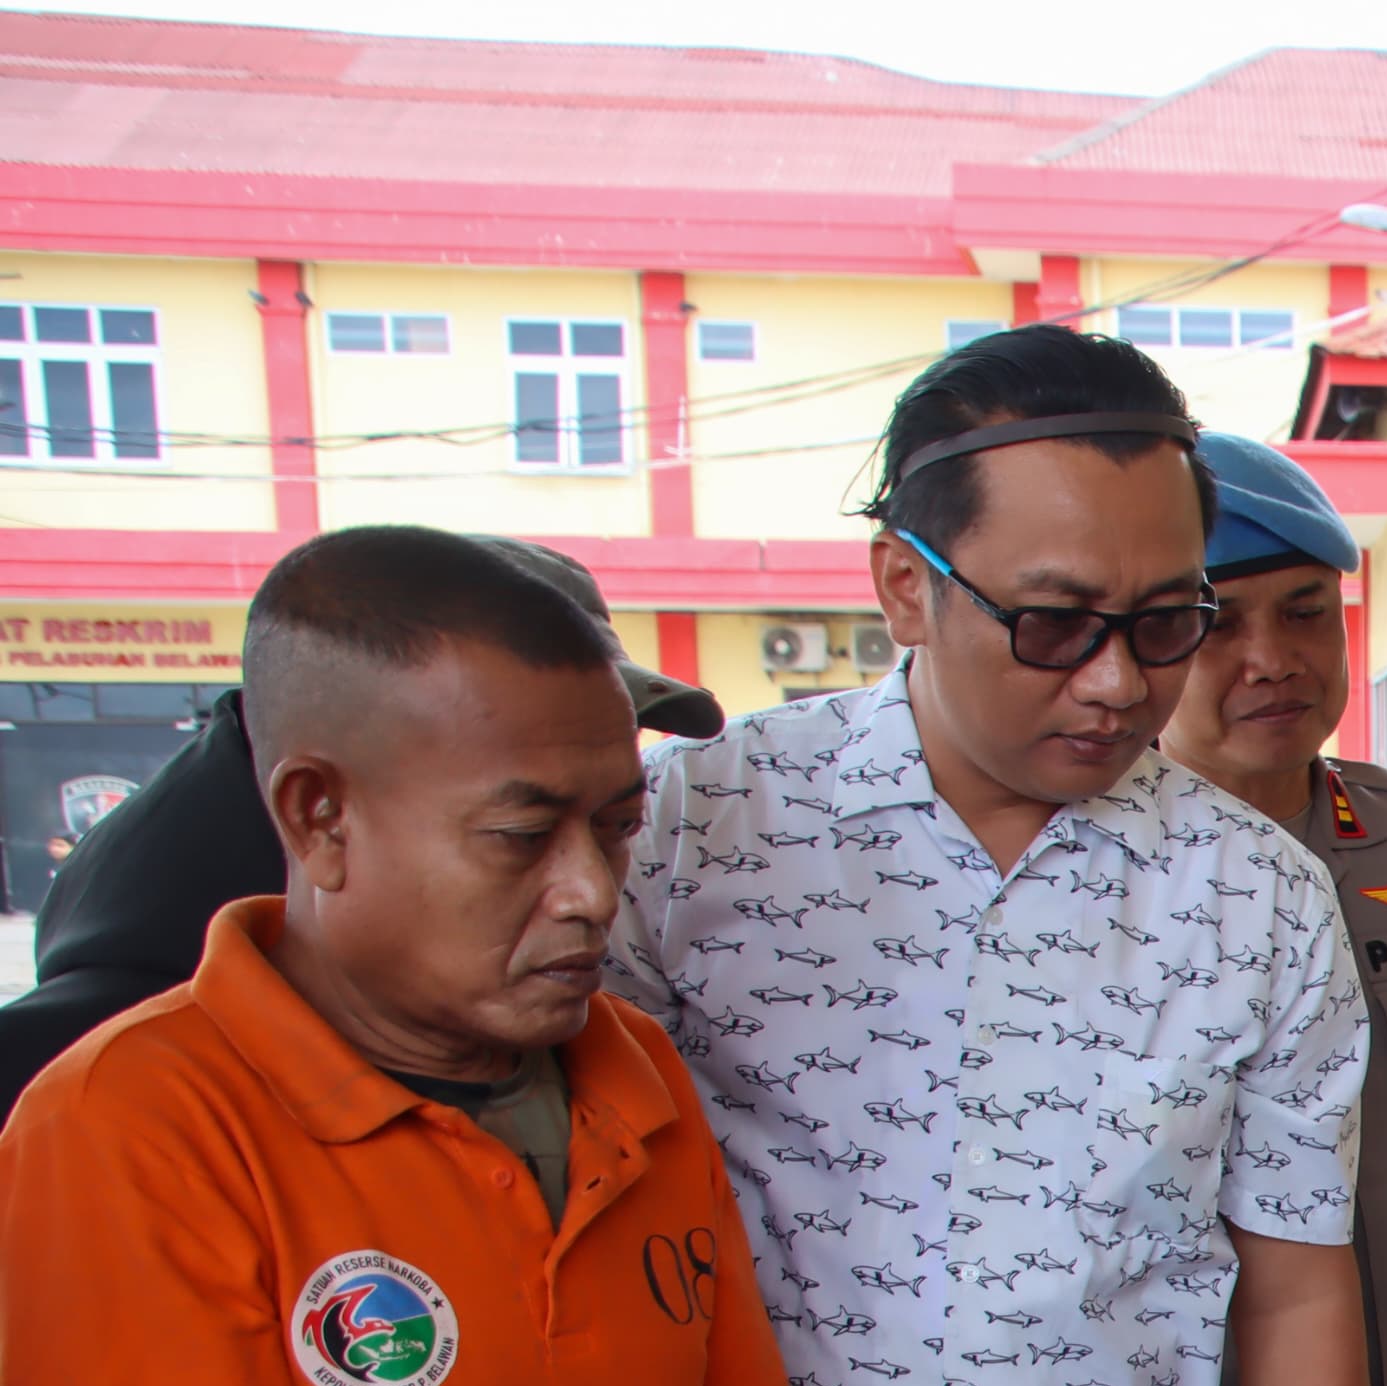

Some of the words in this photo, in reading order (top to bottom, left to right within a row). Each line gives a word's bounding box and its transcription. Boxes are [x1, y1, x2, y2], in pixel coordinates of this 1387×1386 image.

[42, 618, 212, 643] RESKRIM
[9, 651, 145, 667] PELABUHAN
[306, 1270, 337, 1304] SATUAN
[334, 1255, 387, 1276] RESERSE
[388, 1260, 434, 1297] NARKOBA
[426, 1336, 455, 1383] BELAWAN
